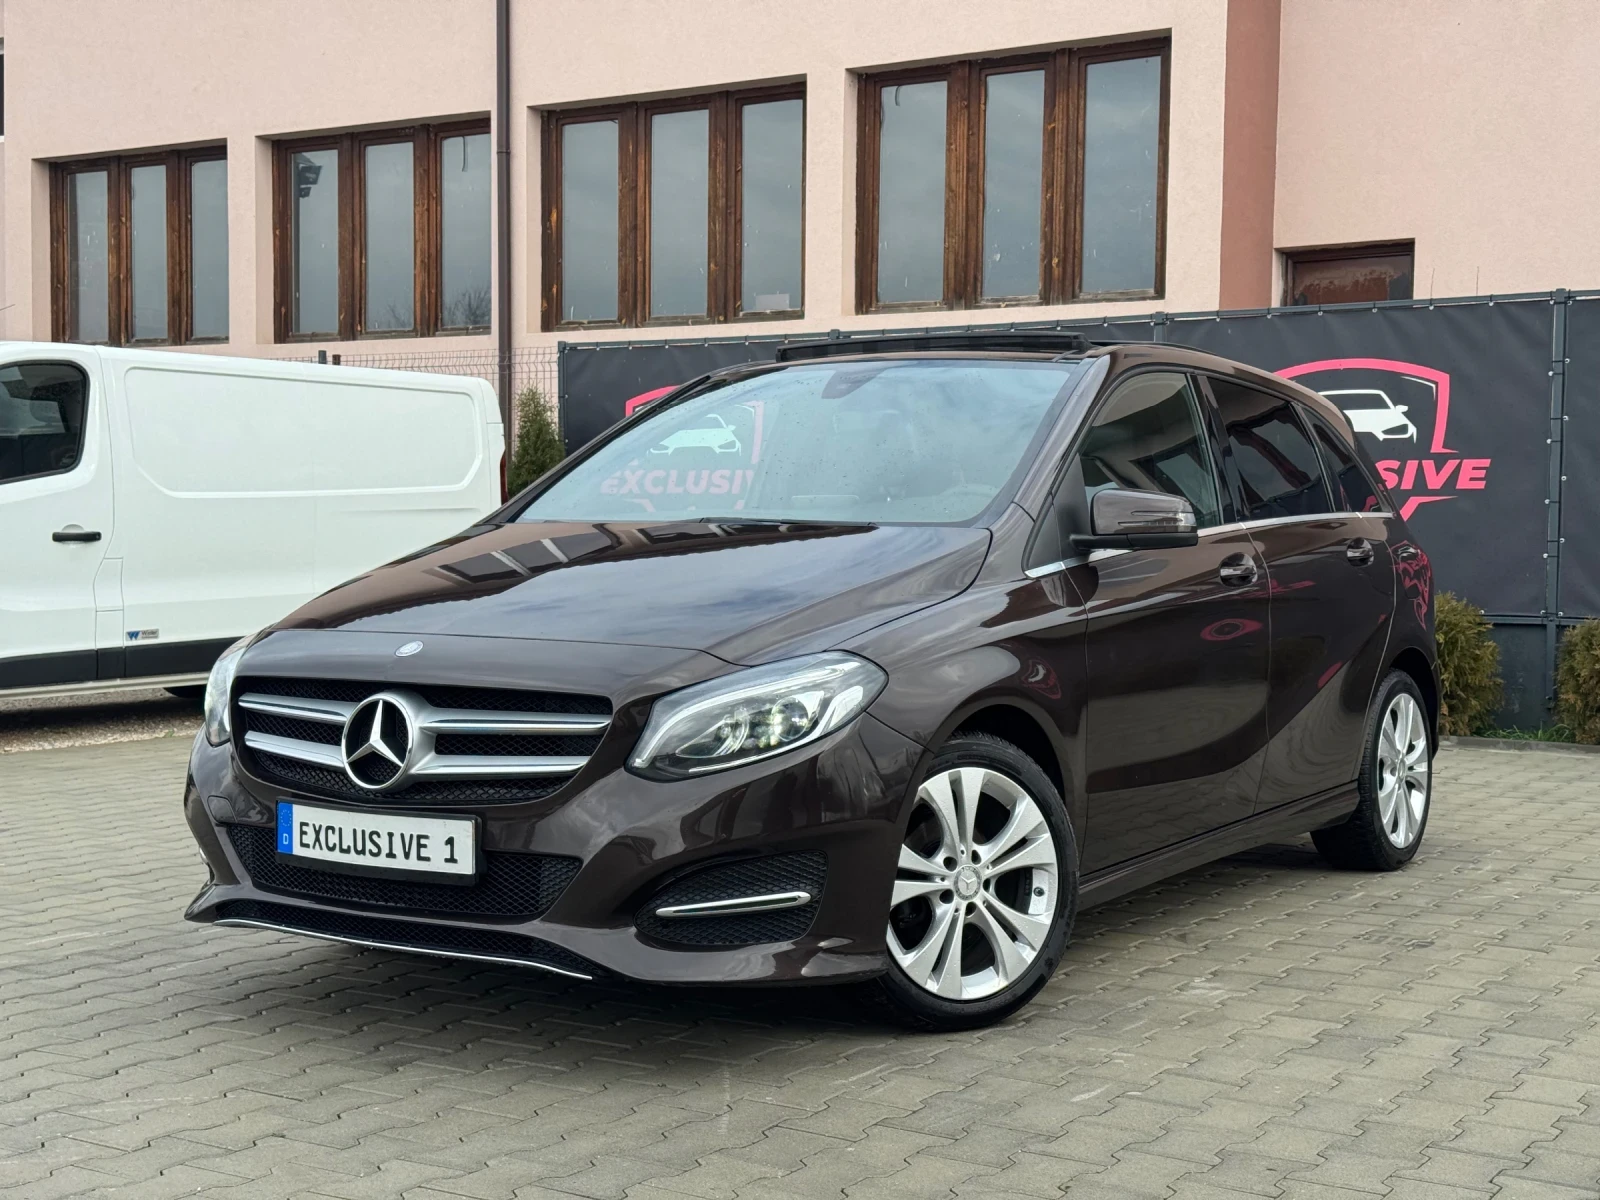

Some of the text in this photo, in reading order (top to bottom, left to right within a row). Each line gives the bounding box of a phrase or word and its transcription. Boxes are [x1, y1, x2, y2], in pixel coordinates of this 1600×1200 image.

[1375, 458, 1492, 490] SIVE
[282, 821, 459, 864] D EXCLUSIVE 1
